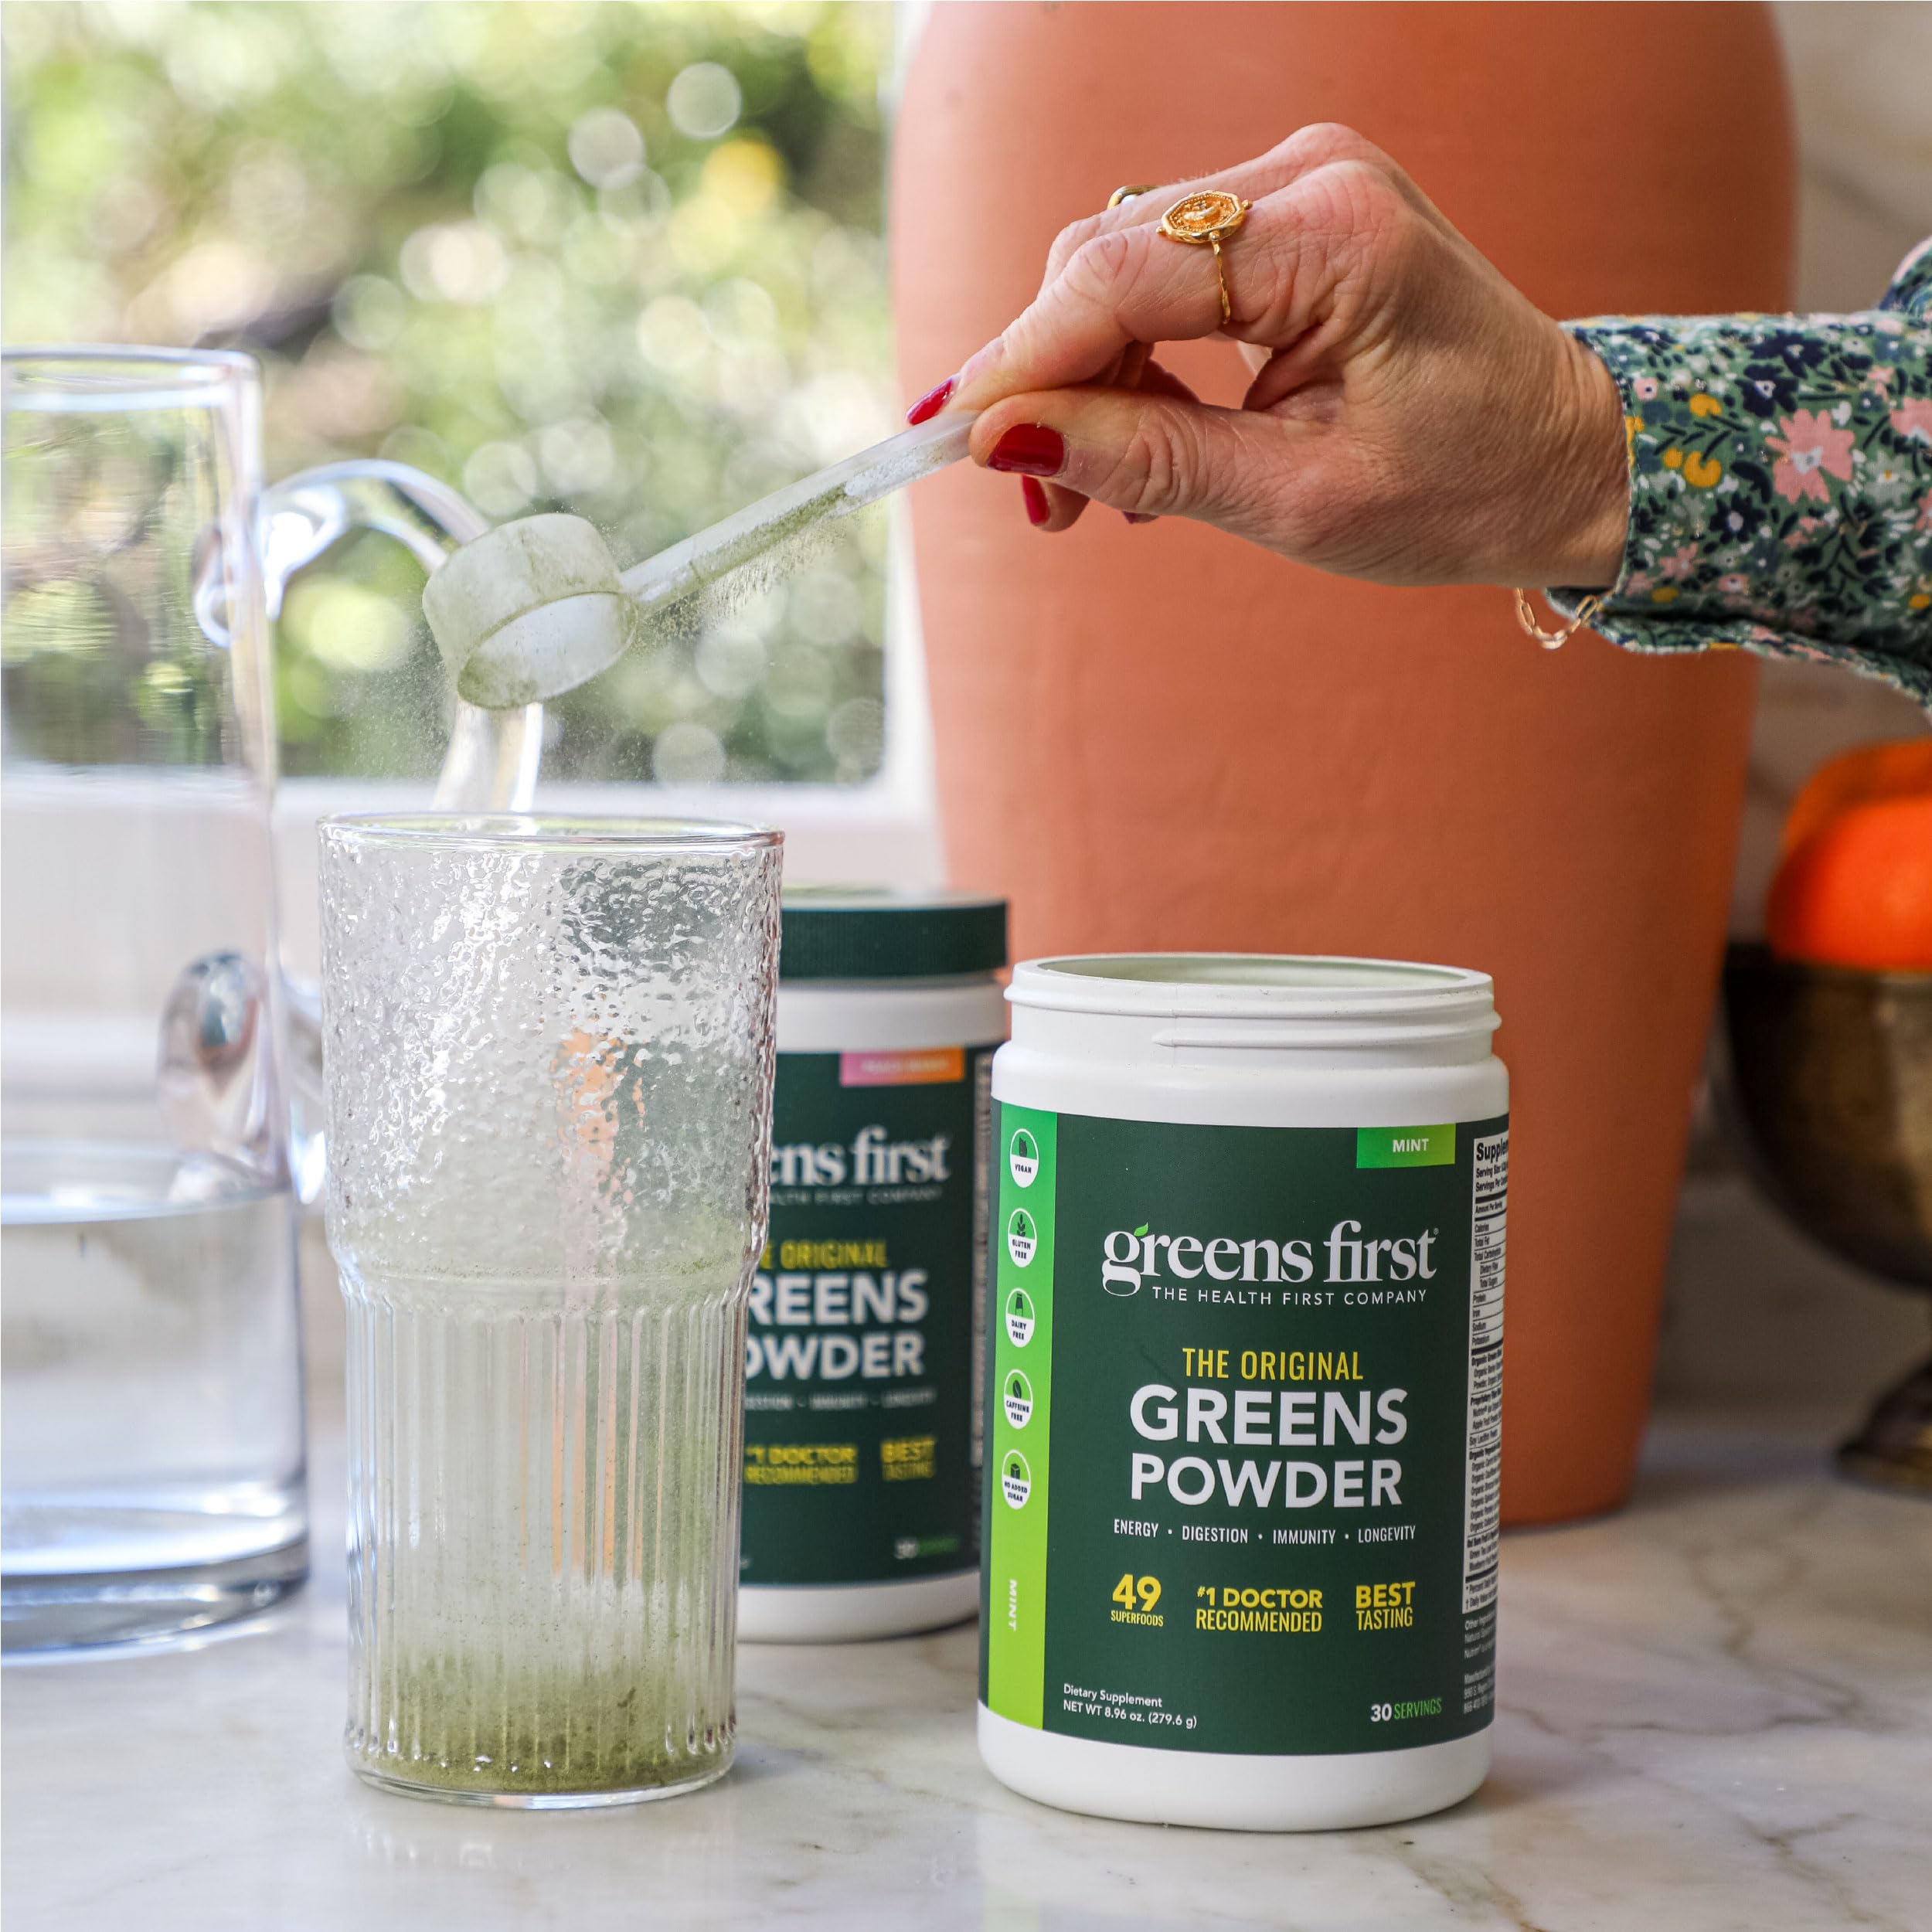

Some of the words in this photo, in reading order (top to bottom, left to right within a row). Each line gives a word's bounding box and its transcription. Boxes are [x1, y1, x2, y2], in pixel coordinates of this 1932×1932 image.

[852, 1125, 950, 1185] first
[1392, 1138, 1429, 1152] MINT
[1015, 1164, 1032, 1174] VEGAN
[1476, 1167, 1493, 1178] Serving
[1475, 1180, 1495, 1192] Servings
[781, 1240, 887, 1269] ORIGINAL
[1012, 1239, 1031, 1250] GLUTEN
[1015, 1250, 1027, 1260] FREE
[1102, 1223, 1313, 1297] greens
[748, 1269, 929, 1325] REENS
[1152, 1286, 1188, 1301] THE
[1198, 1288, 1272, 1305] HEALTH
[1283, 1291, 1335, 1306] FIRST
[1344, 1288, 1427, 1305] COMPANY
[1011, 1319, 1026, 1331] DAIRY
[1012, 1330, 1025, 1341] FREE
[747, 1332, 925, 1380] OWDER
[1182, 1348, 1230, 1379] THE
[1240, 1350, 1363, 1381] ORIGINAL
[1006, 1400, 1029, 1413] CAFFEINE
[1011, 1412, 1023, 1422] FREE
[1129, 1384, 1408, 1446] GREENS
[1131, 1452, 1403, 1508] POWDER
[1007, 1491, 1024, 1503] SUGAR
[1114, 1519, 1158, 1538] ENERGY
[1182, 1525, 1248, 1544] DIGESTION
[1273, 1529, 1335, 1545] IMMUNITY
[1358, 1525, 1416, 1544] LONGEVITY
[1112, 1573, 1162, 1612] 49
[1196, 1586, 1216, 1607] #1
[1223, 1588, 1322, 1610] DOCTOR
[1355, 1581, 1416, 1607] BEST
[1009, 1579, 1018, 1631] MINT
[1110, 1610, 1164, 1628] SUPERFOODS
[1196, 1610, 1322, 1632] RECOMMENDED
[1357, 1607, 1413, 1631] TASTING
[1063, 1683, 1097, 1702] Dietary
[1100, 1687, 1162, 1709] Supplement
[1063, 1699, 1083, 1713] NET
[1085, 1702, 1103, 1715] WT
[1104, 1705, 1127, 1719] 8.96
[1128, 1711, 1145, 1723] oz.
[1148, 1710, 1182, 1726] (279.6
[1185, 1714, 1198, 1729] g)
[1370, 1703, 1392, 1722] 30
[1393, 1697, 1442, 1719] SERVINGS
